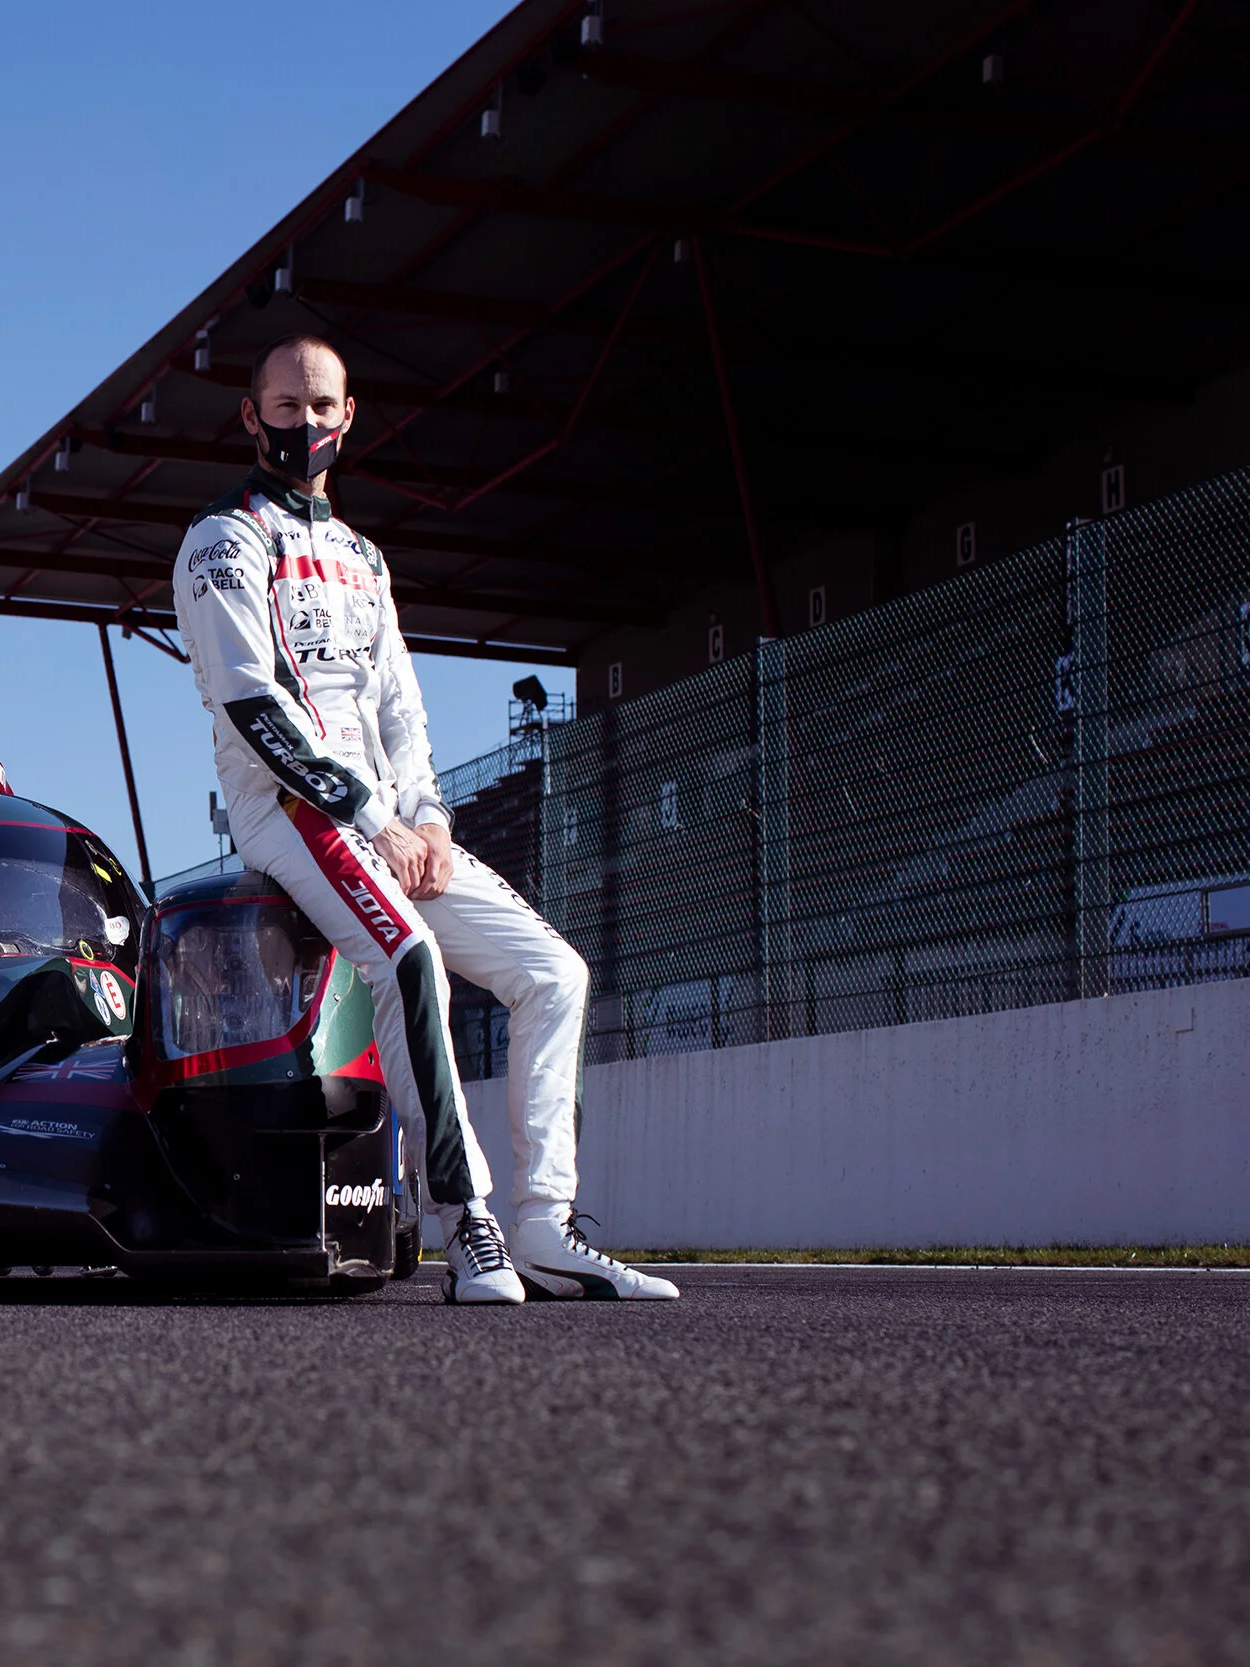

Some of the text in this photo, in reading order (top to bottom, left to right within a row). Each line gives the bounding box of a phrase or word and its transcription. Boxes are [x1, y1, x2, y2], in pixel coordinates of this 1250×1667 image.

[1107, 469, 1120, 508] H
[188, 539, 241, 573] Coca-Cola
[961, 527, 972, 561] G
[208, 567, 244, 579] TACO
[212, 579, 245, 590] BELL
[713, 630, 721, 658] C
[250, 718, 327, 792] TURBO
[341, 880, 400, 943] JOTA
[30, 1119, 78, 1131] ACTION
[56, 1127, 95, 1139] SAFETY
